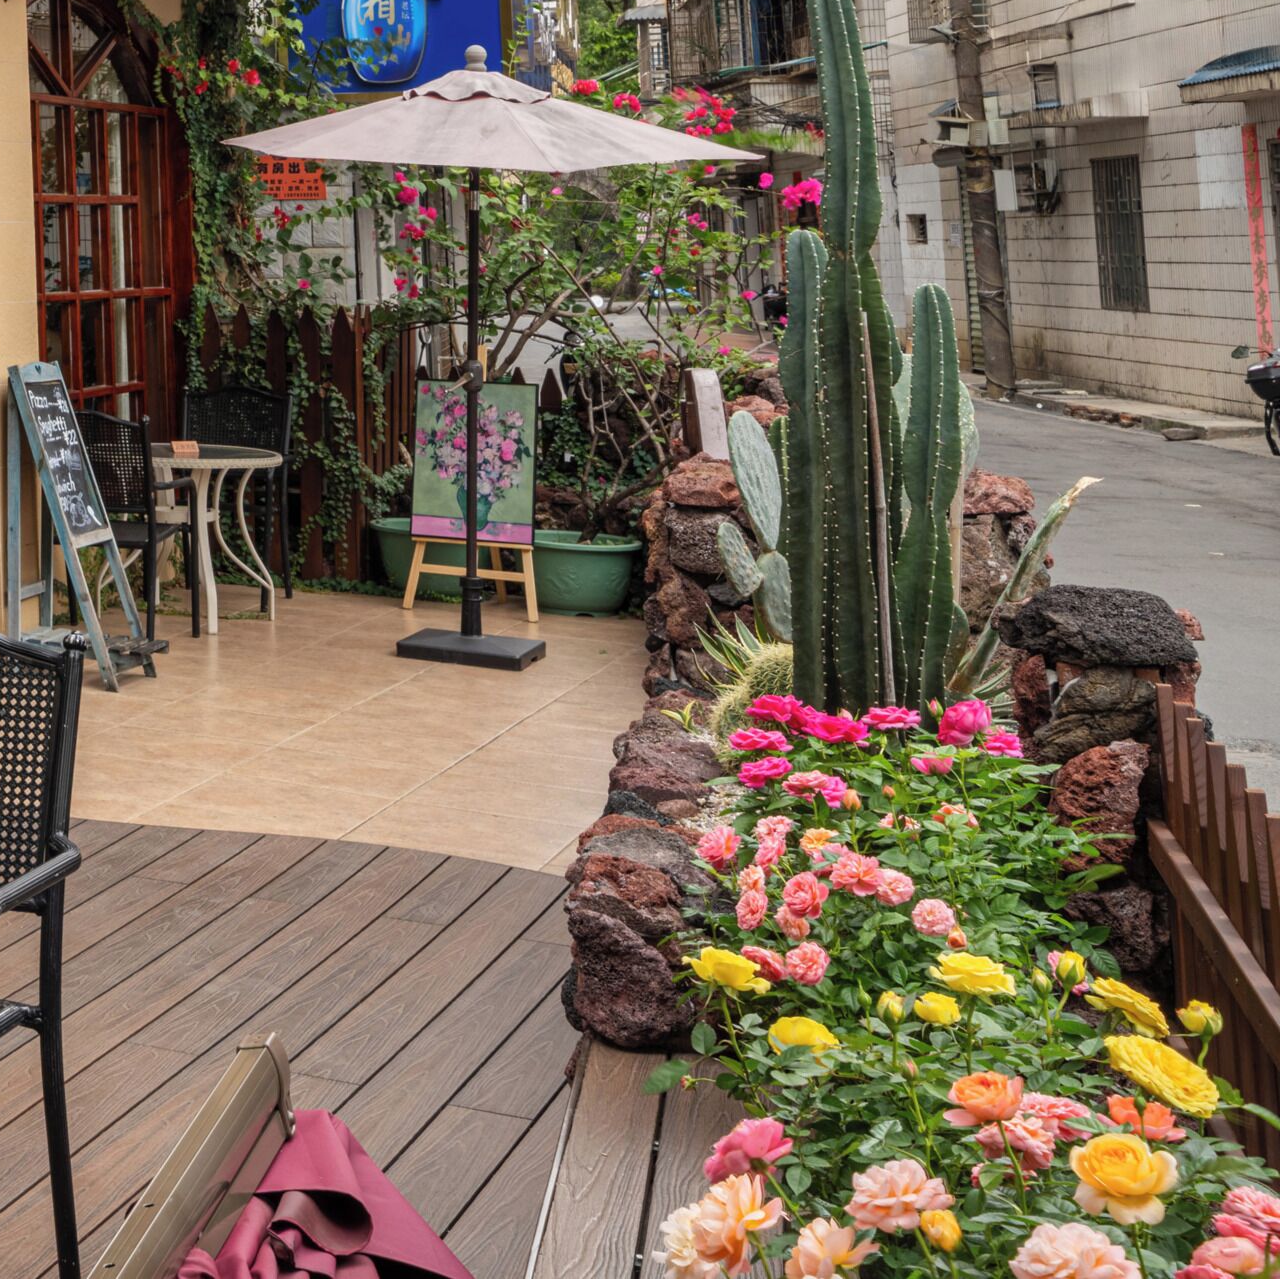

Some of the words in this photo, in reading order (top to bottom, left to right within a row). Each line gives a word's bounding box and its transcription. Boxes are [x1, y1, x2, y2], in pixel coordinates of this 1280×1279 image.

[257, 161, 318, 174] 有房出
[28, 389, 49, 409] Pizza
